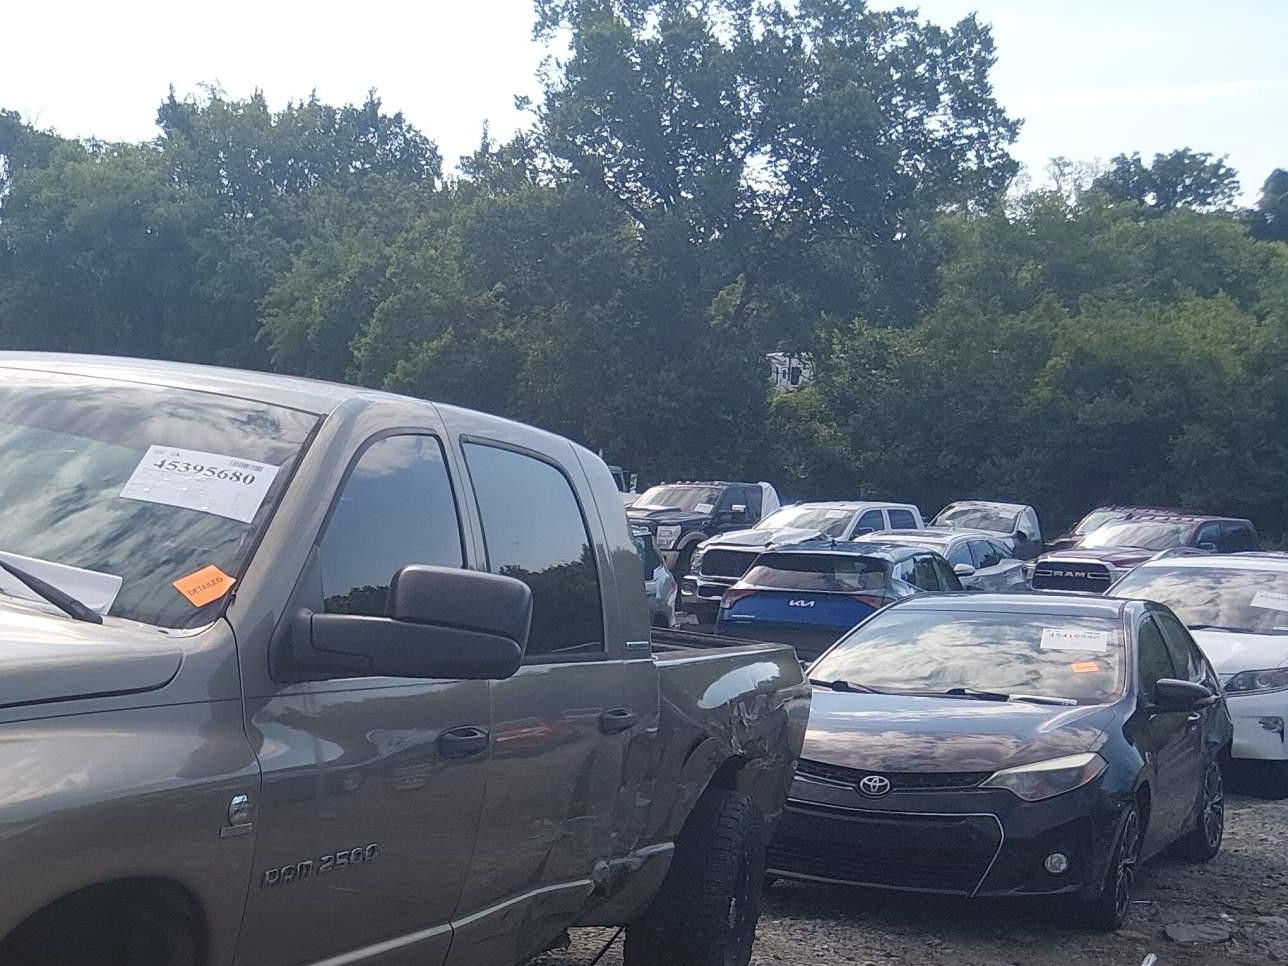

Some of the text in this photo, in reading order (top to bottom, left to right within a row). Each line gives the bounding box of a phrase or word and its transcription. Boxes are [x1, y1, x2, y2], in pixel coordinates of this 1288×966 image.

[153, 458, 256, 486] 45395680
[1053, 570, 1086, 578] RAM
[186, 575, 224, 598] DETAILED
[788, 599, 816, 608] KIA
[261, 842, 380, 888] RAM 2500
